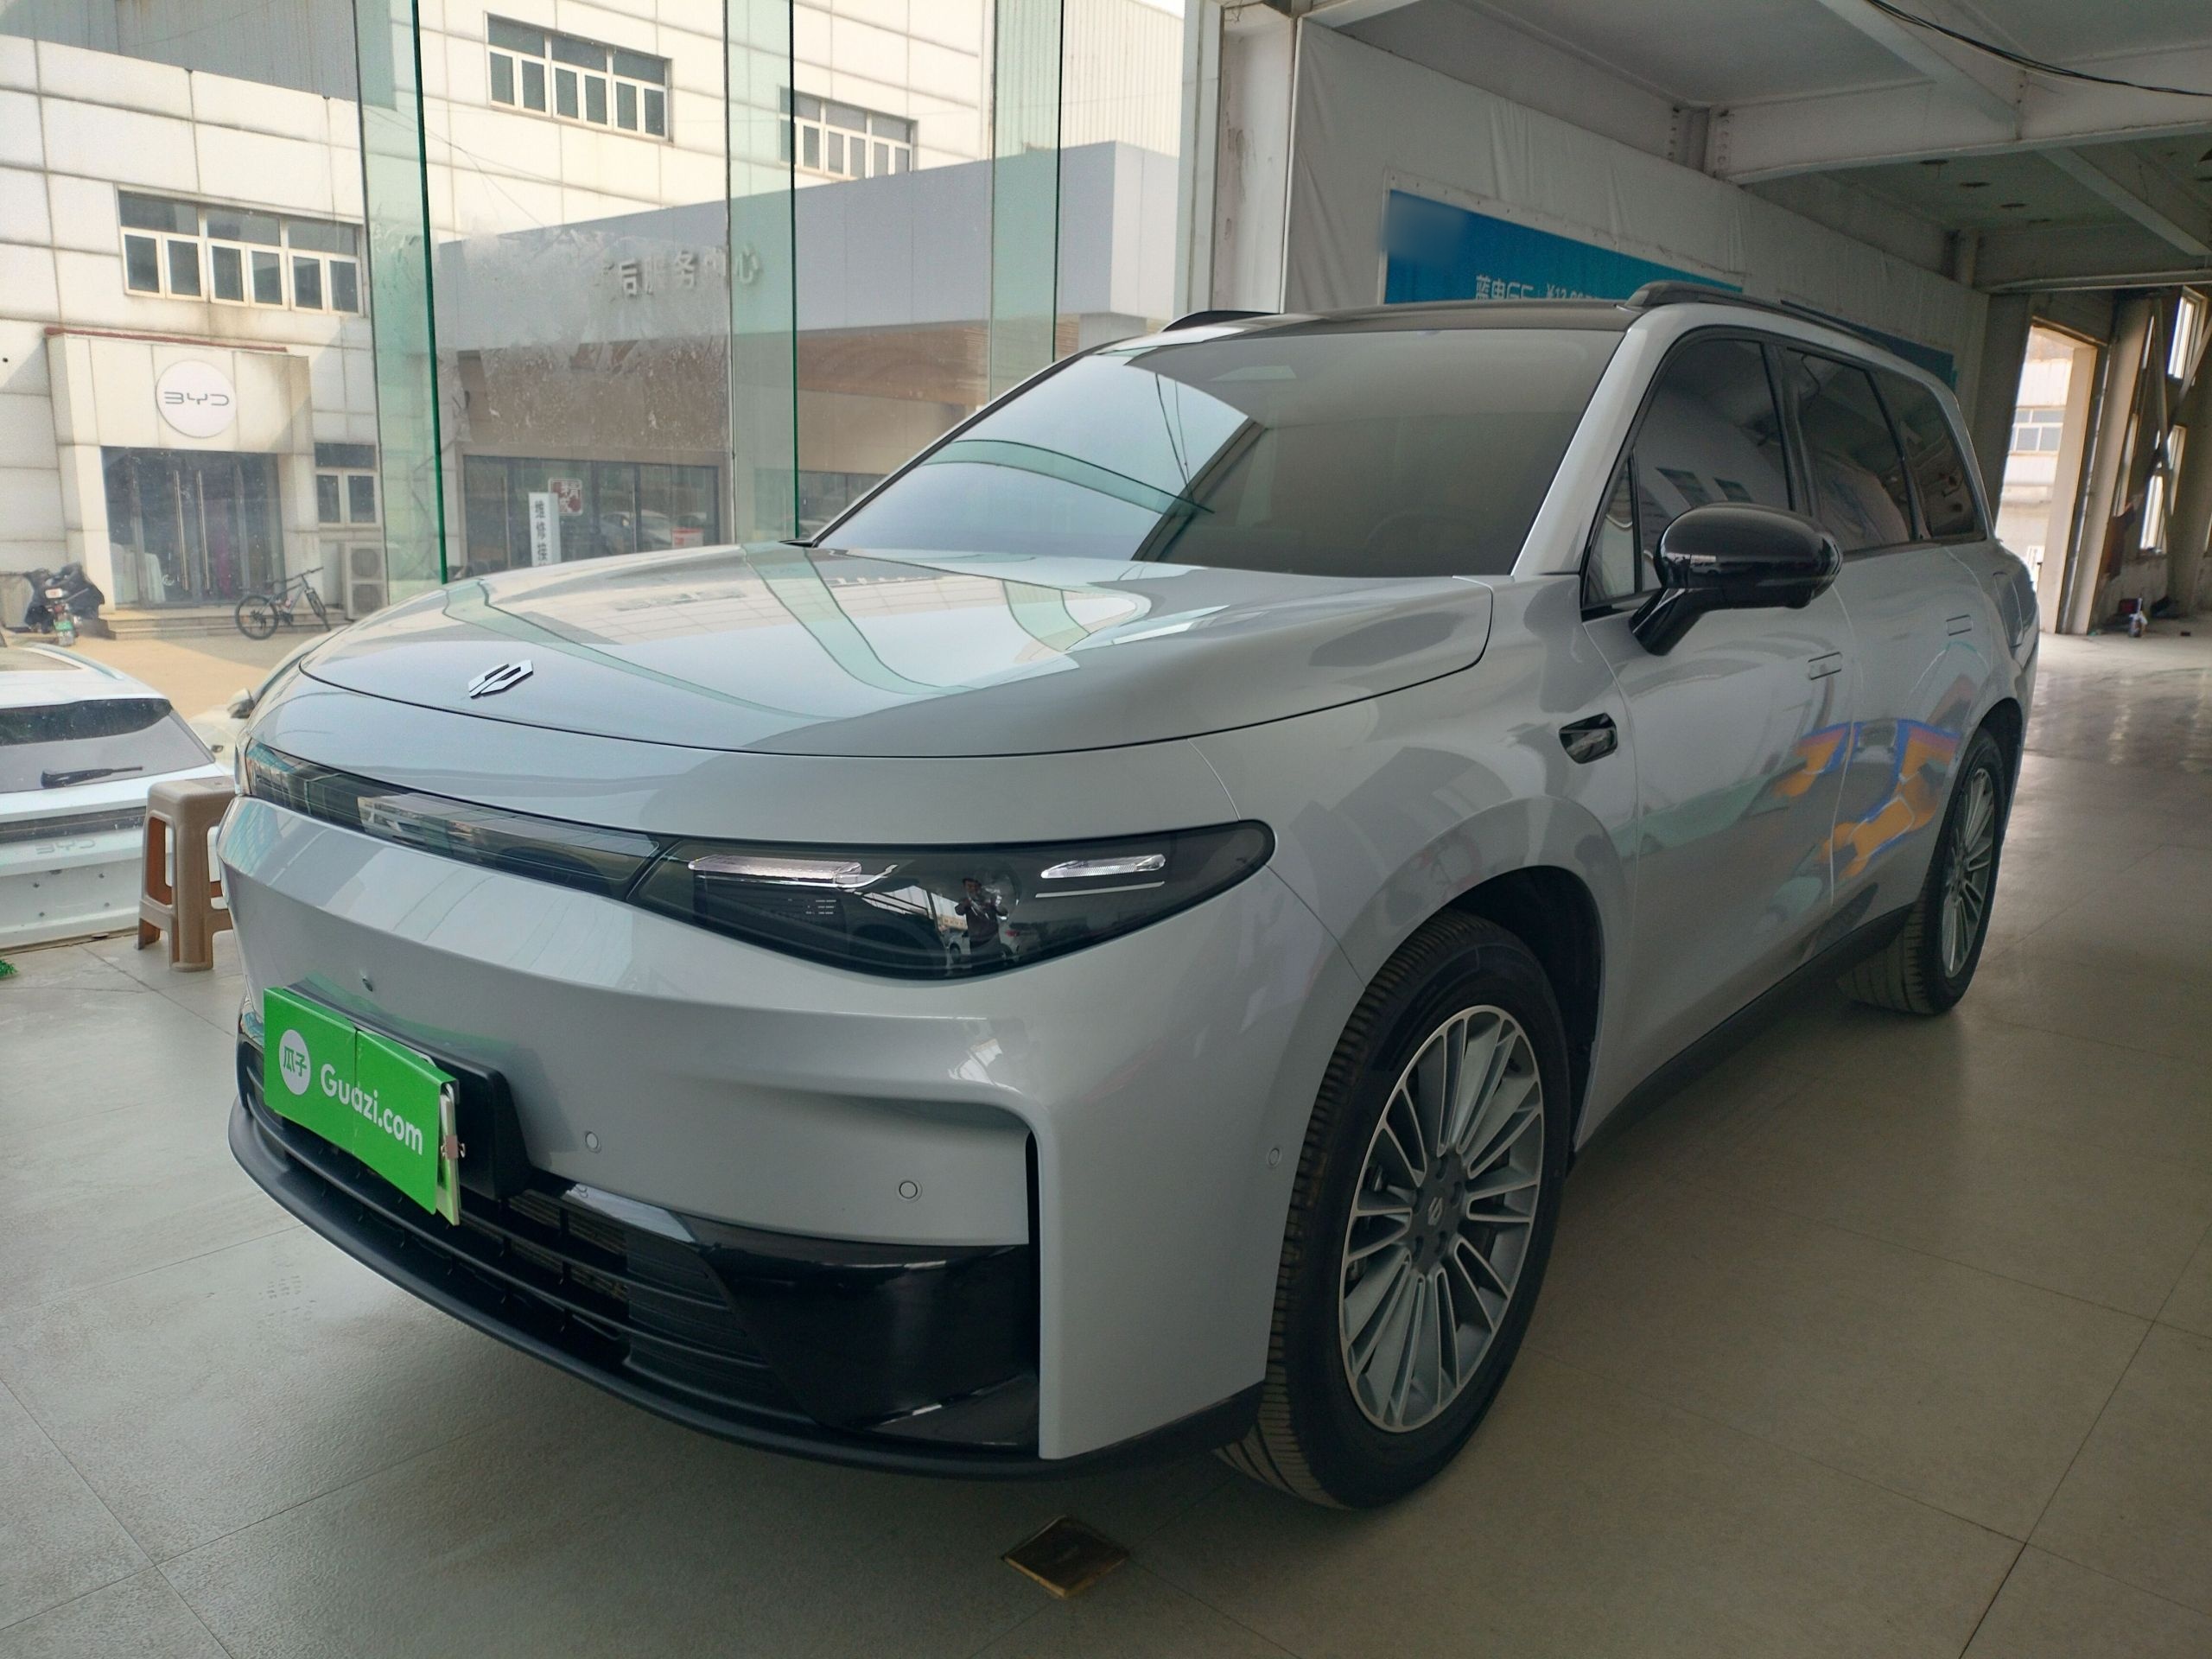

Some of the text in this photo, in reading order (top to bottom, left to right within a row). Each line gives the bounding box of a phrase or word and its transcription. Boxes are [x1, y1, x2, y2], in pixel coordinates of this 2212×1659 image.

[164, 391, 230, 406] BYD
[283, 1046, 307, 1077] 瓜子
[320, 1063, 423, 1156] Guazi.com
